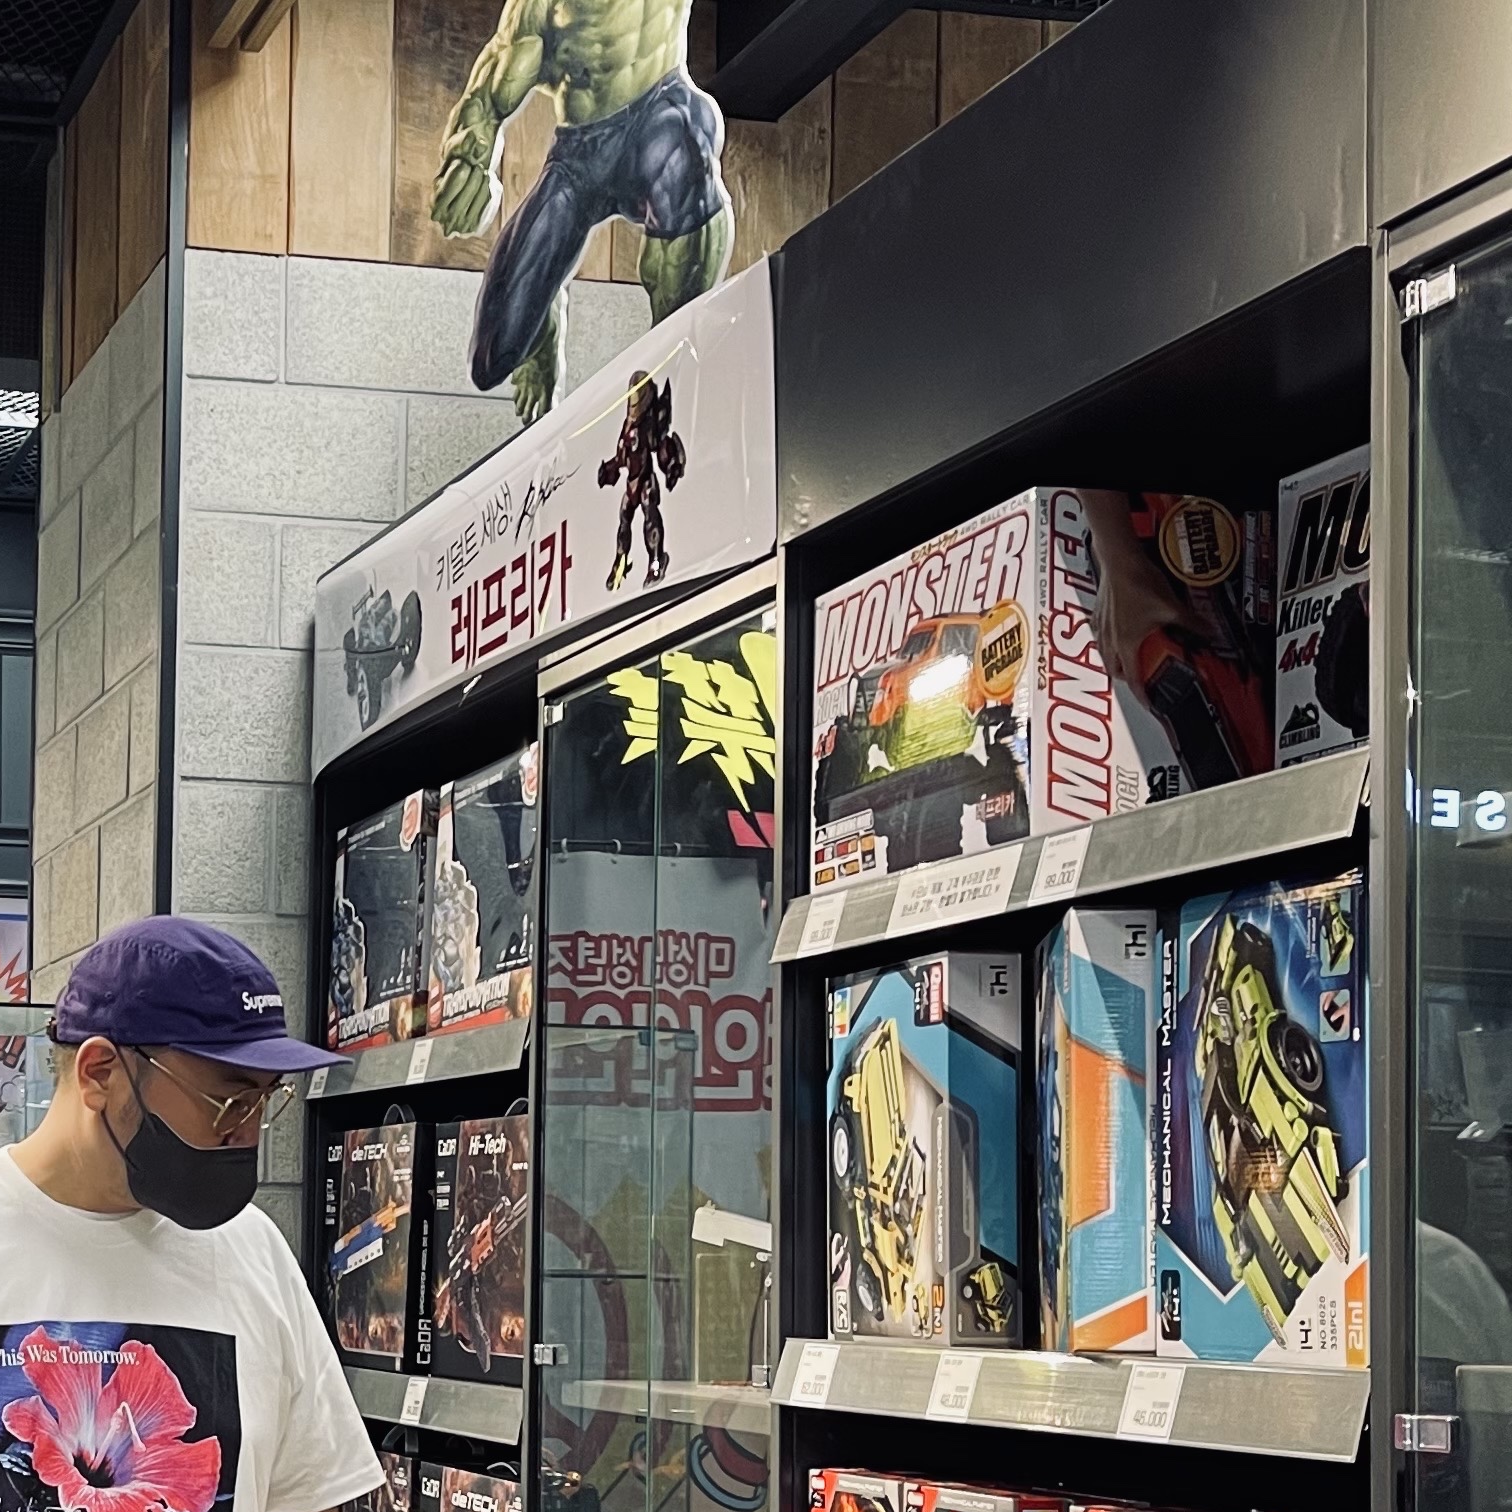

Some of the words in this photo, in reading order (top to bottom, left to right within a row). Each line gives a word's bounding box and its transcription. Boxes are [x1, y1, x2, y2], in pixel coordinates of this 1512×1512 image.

[980, 508, 1008, 527] RALLY
[1039, 497, 1049, 526] CAR
[1039, 539, 1049, 584] RALLY
[451, 519, 573, 671] 레프리카
[818, 508, 1030, 693] MONSTER
[1038, 589, 1048, 609] 4WD
[981, 622, 1022, 668] BATTERY
[1160, 939, 1173, 1046] MASTER
[467, 1133, 507, 1157] Hi-Tech
[1160, 1057, 1172, 1225] MECHANICAL
[935, 1206, 944, 1263] MASTER
[26, 1344, 58, 1364] Was
[1319, 1328, 1327, 1350] NO
